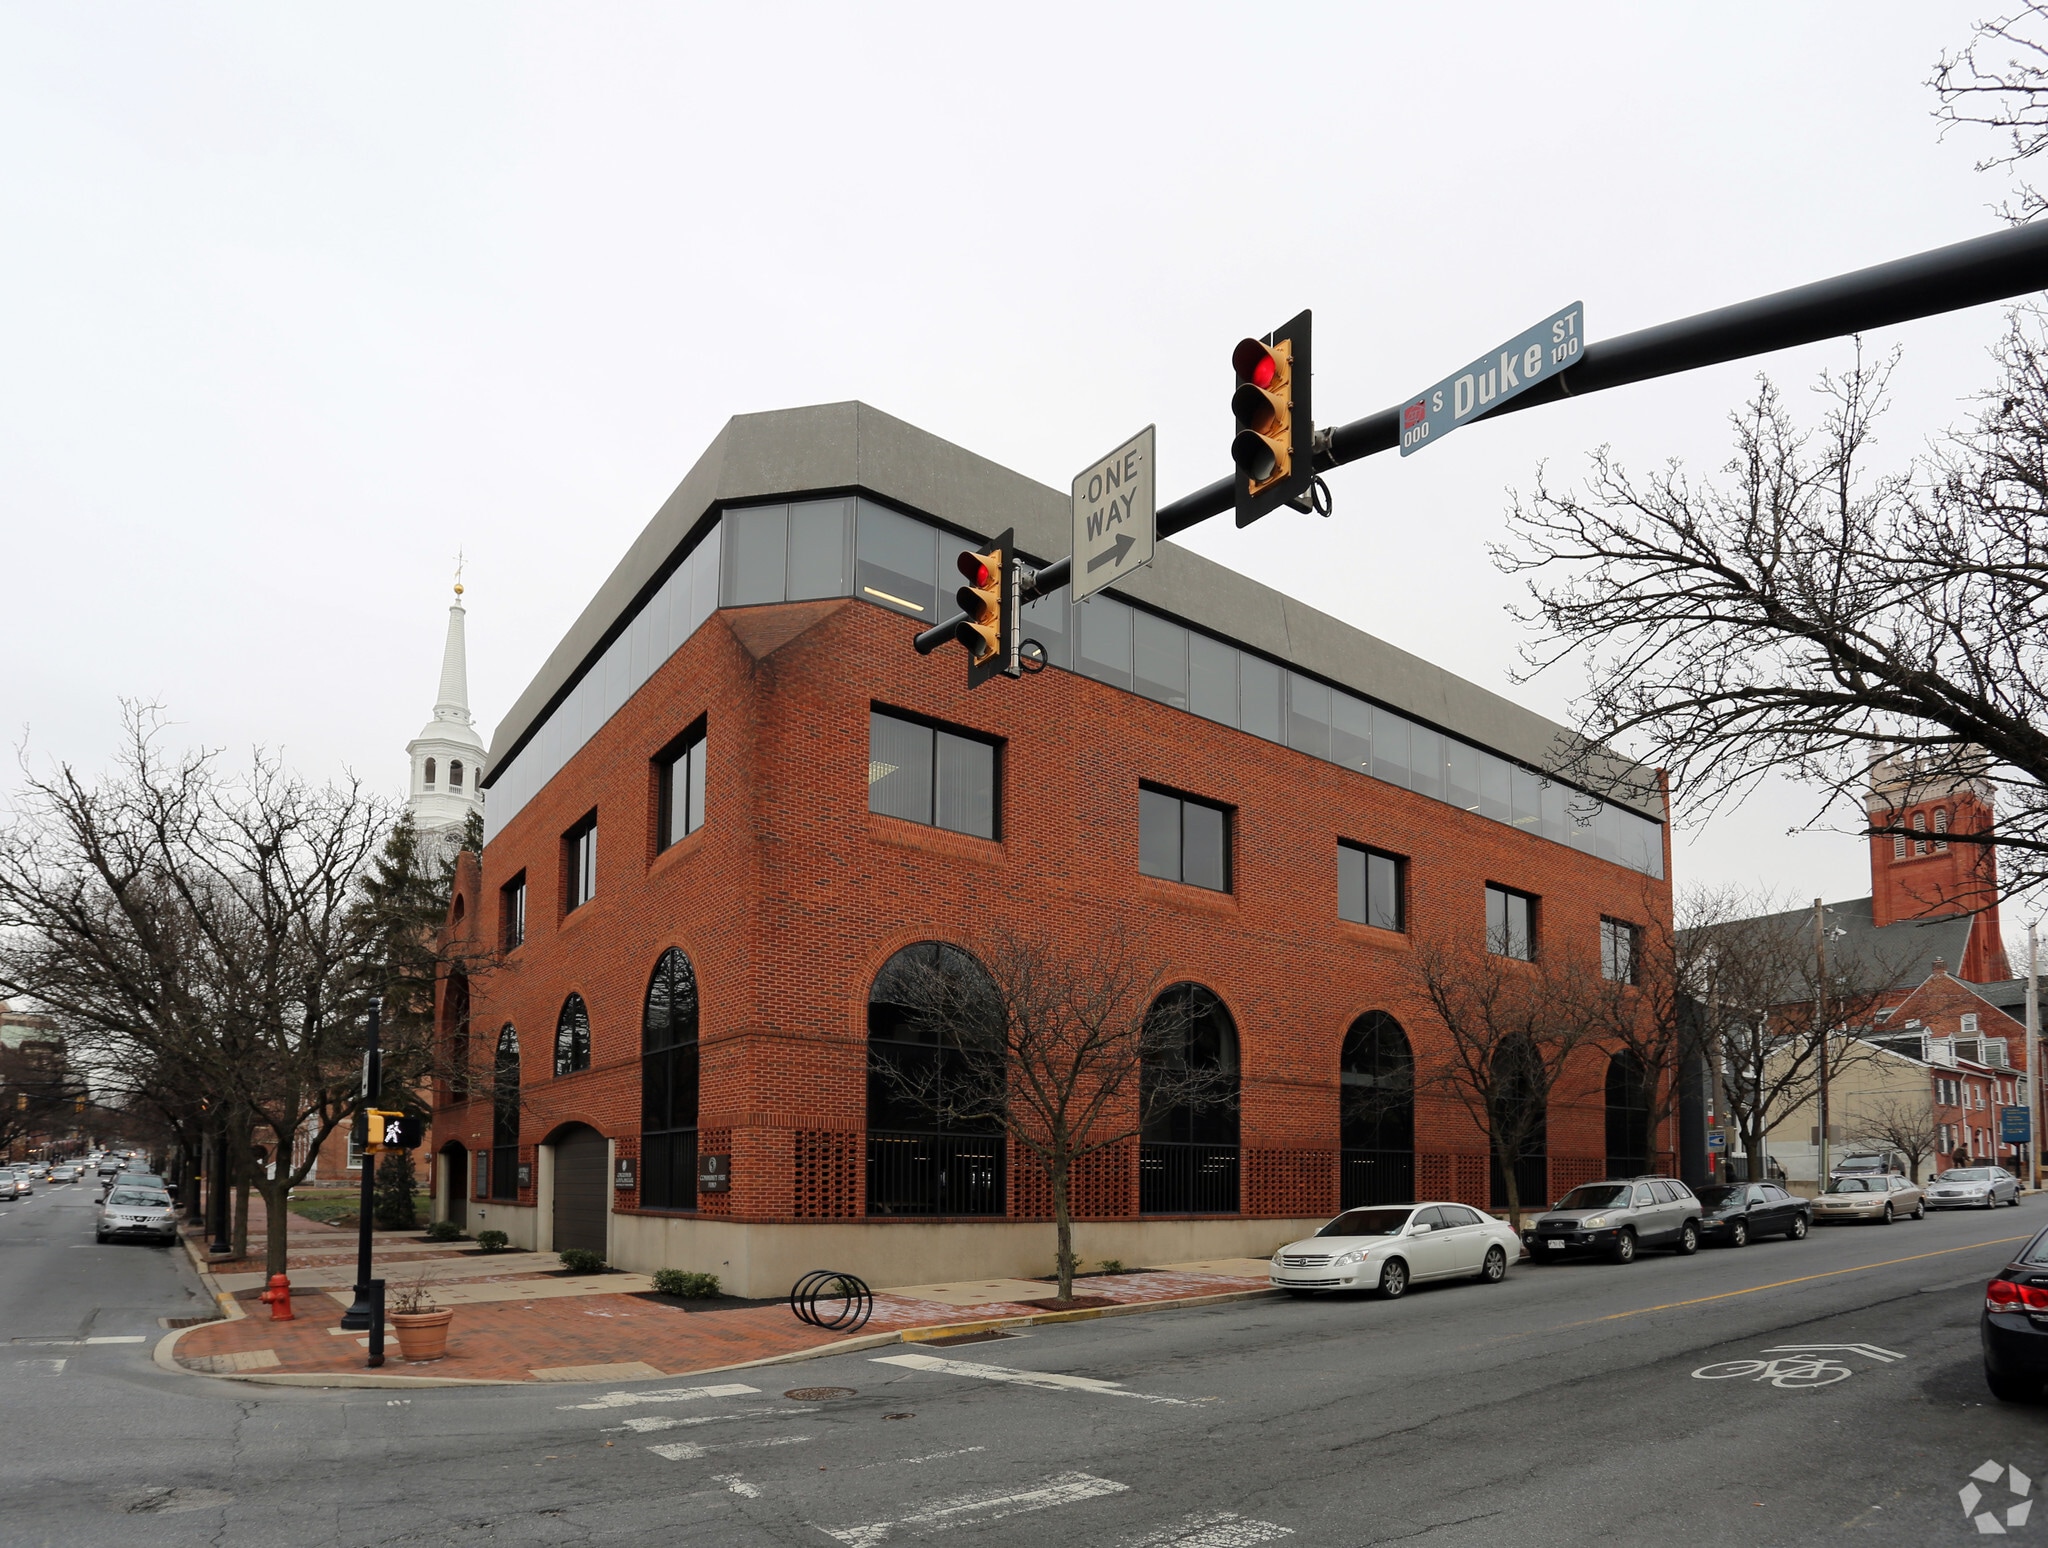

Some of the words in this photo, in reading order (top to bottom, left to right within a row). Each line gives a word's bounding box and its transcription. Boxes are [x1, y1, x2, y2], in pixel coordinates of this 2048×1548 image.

[1432, 390, 1444, 413] S
[1455, 343, 1542, 420] Duke
[1552, 310, 1578, 344] ST
[1551, 336, 1578, 365] 100
[1404, 421, 1429, 447] 000
[1088, 449, 1137, 504] ONE
[1086, 485, 1137, 542] WAY
